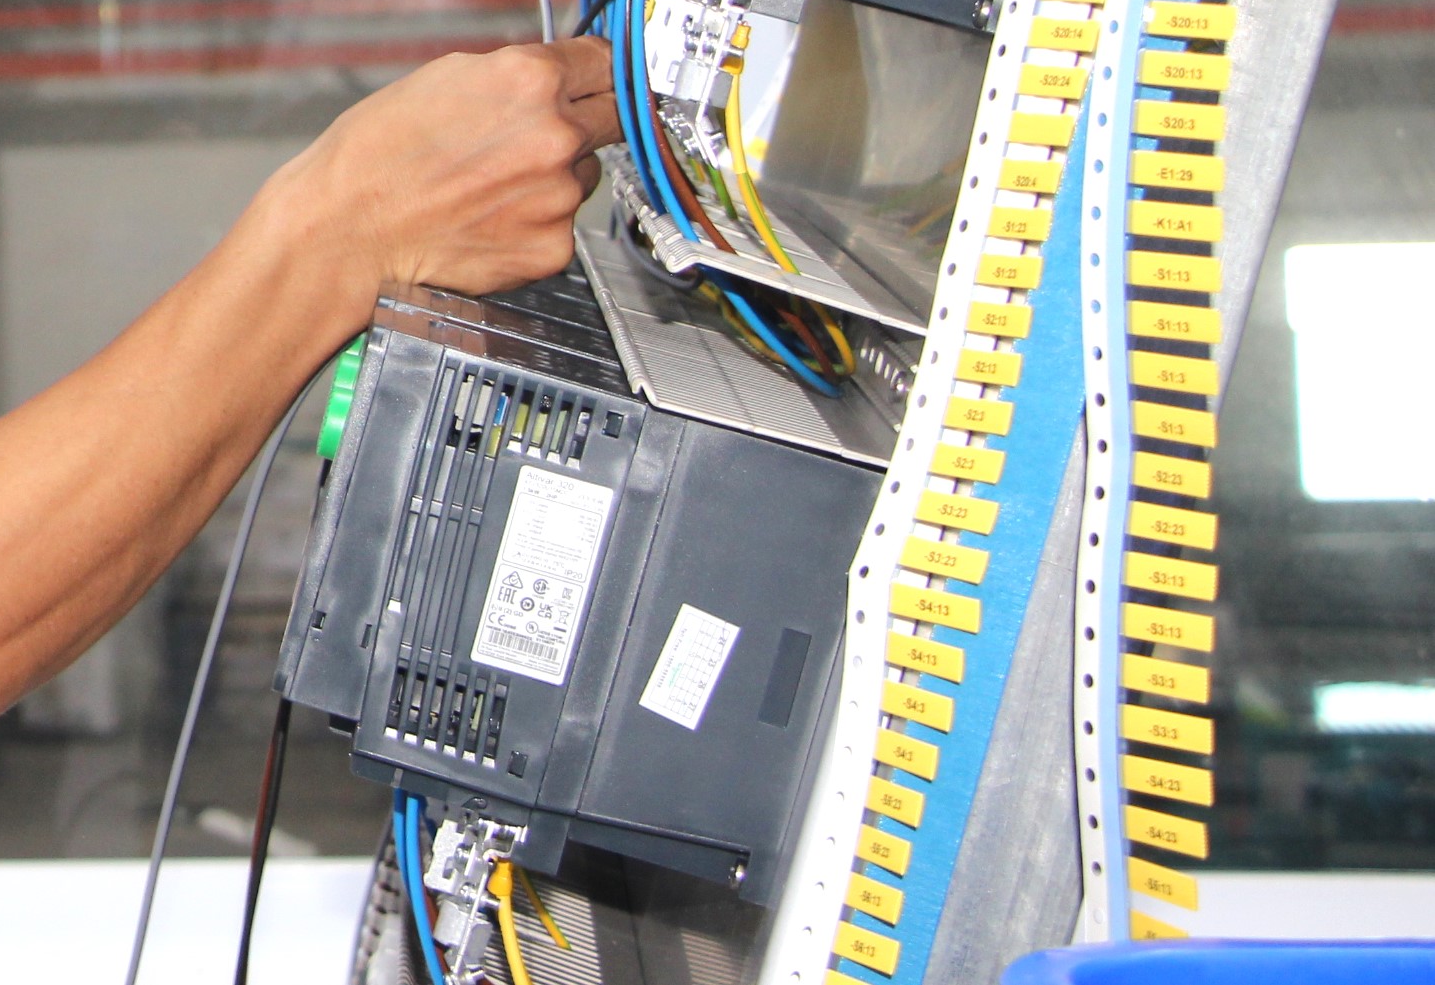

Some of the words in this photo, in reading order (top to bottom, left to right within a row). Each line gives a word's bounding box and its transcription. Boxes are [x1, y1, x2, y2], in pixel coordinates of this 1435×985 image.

[1166, 17, 1209, 30] -S20:13
[1050, 26, 1083, 39] -S20:14
[1039, 74, 1071, 87] -S20:24
[1160, 66, 1204, 80] -S20:13
[1159, 117, 1196, 130] -S20:3
[1156, 168, 1193, 181] -E1:29
[1153, 218, 1193, 232] -K1:A1
[1153, 268, 1191, 283] -S1:13
[1153, 319, 1190, 333] -S1:13
[1157, 370, 1186, 384] -S1:3
[1158, 421, 1185, 435] -S1:3
[1152, 470, 1183, 486] -S2:23
[937, 504, 968, 519] -S3:23
[1150, 521, 1186, 536] -S2:23
[924, 551, 957, 567] -S3:23
[1148, 571, 1186, 588] -S3:13
[915, 599, 950, 616] -S4:13
[1146, 622, 1182, 639] -S3:13
[907, 648, 937, 666] -S4:13
[1148, 674, 1176, 689] -S3:3
[902, 697, 925, 714] -S4:3
[1148, 724, 1179, 740] -S3:3
[1146, 775, 1182, 792] -S4:23
[1146, 826, 1178, 844] -S4:23
